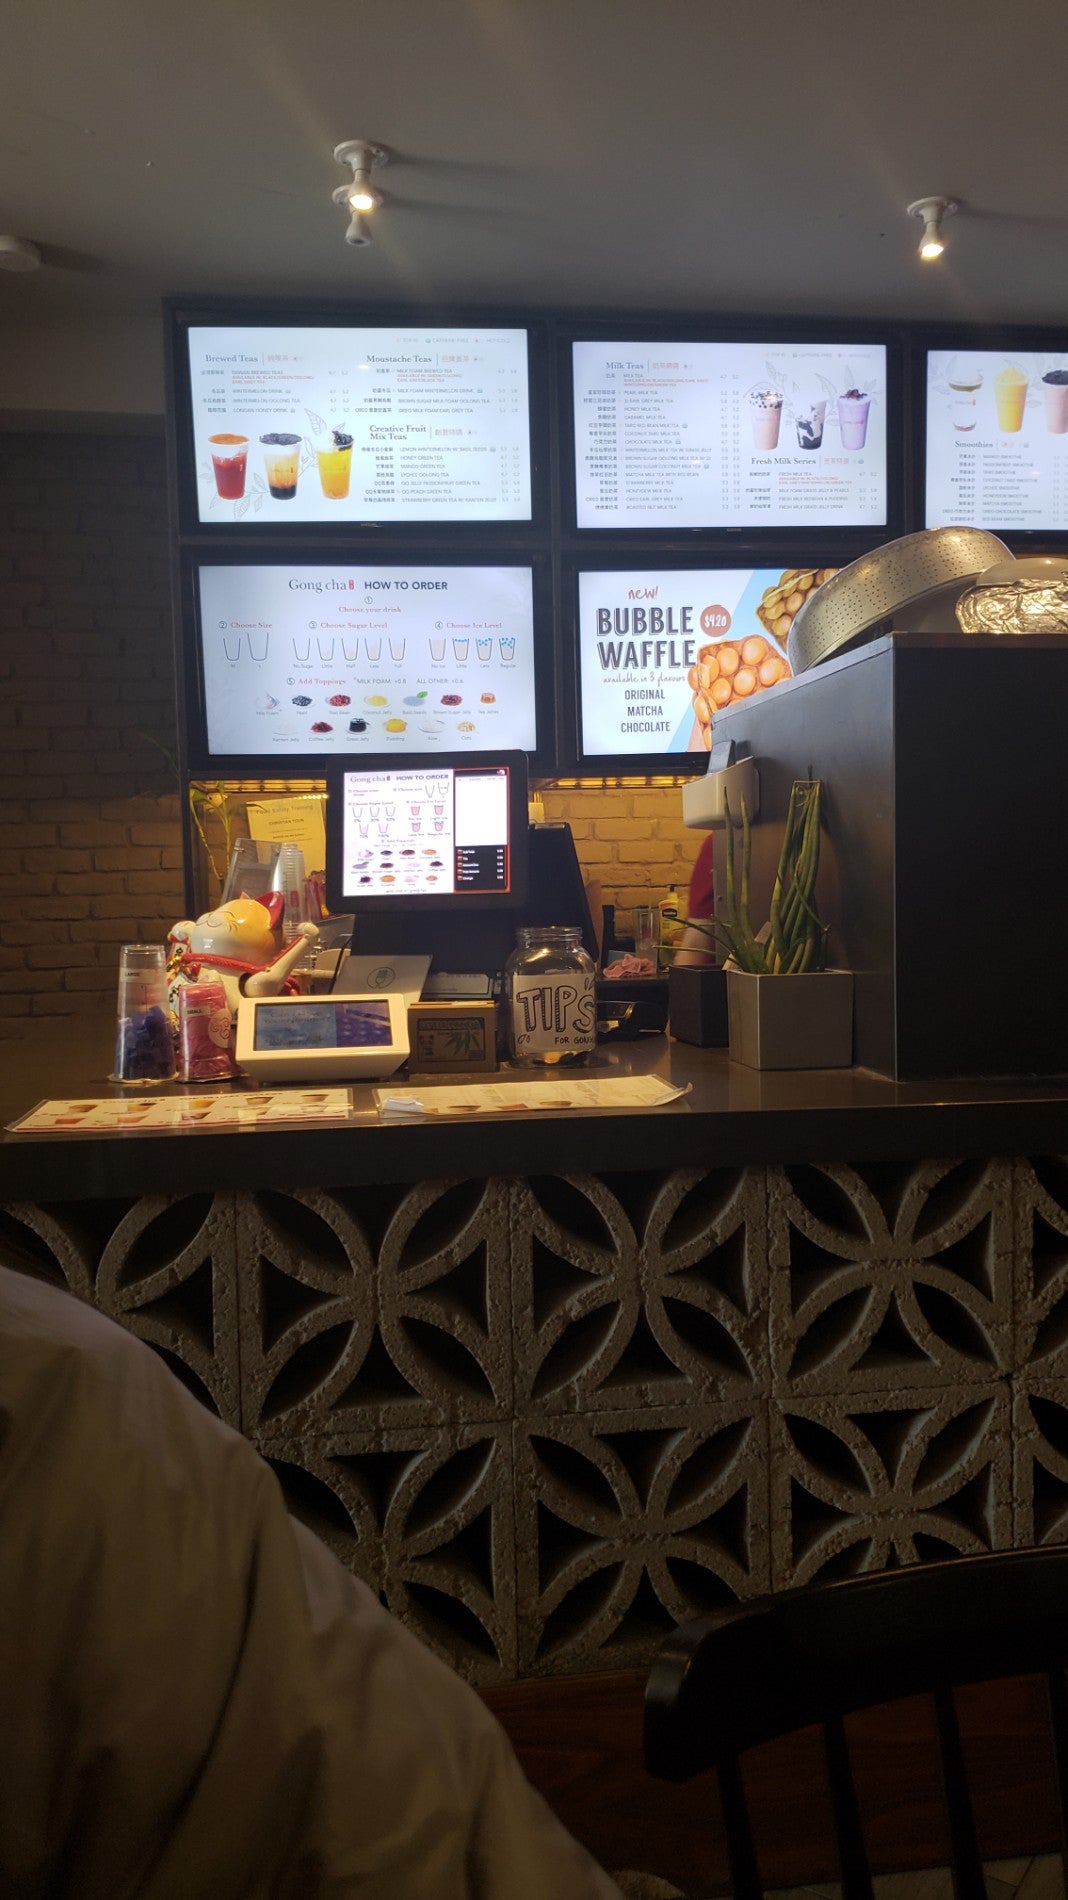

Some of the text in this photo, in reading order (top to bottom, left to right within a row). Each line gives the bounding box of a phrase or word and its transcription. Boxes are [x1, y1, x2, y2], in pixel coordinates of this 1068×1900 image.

[206, 354, 238, 362] Brewed
[240, 354, 259, 362] Teas
[606, 362, 626, 370] Milk
[370, 424, 426, 433] Creative Fruit
[954, 440, 994, 448] Smoothies
[289, 578, 346, 594] Gong cha
[365, 582, 448, 590] HOW TO ORDER
[628, 586, 658, 600] new!
[348, 622, 368, 630] Sugar
[596, 606, 694, 636] BUBBLE
[597, 640, 696, 670] WAFFLE
[315, 678, 346, 686] Toppings
[603, 672, 686, 687] available in 3 flavours
[624, 690, 666, 700] ORIGINAL
[628, 706, 664, 717] MATCHA
[620, 722, 671, 732] CHOCOLATE
[516, 986, 594, 1034] TIPS
[554, 1036, 570, 1045] FOR
